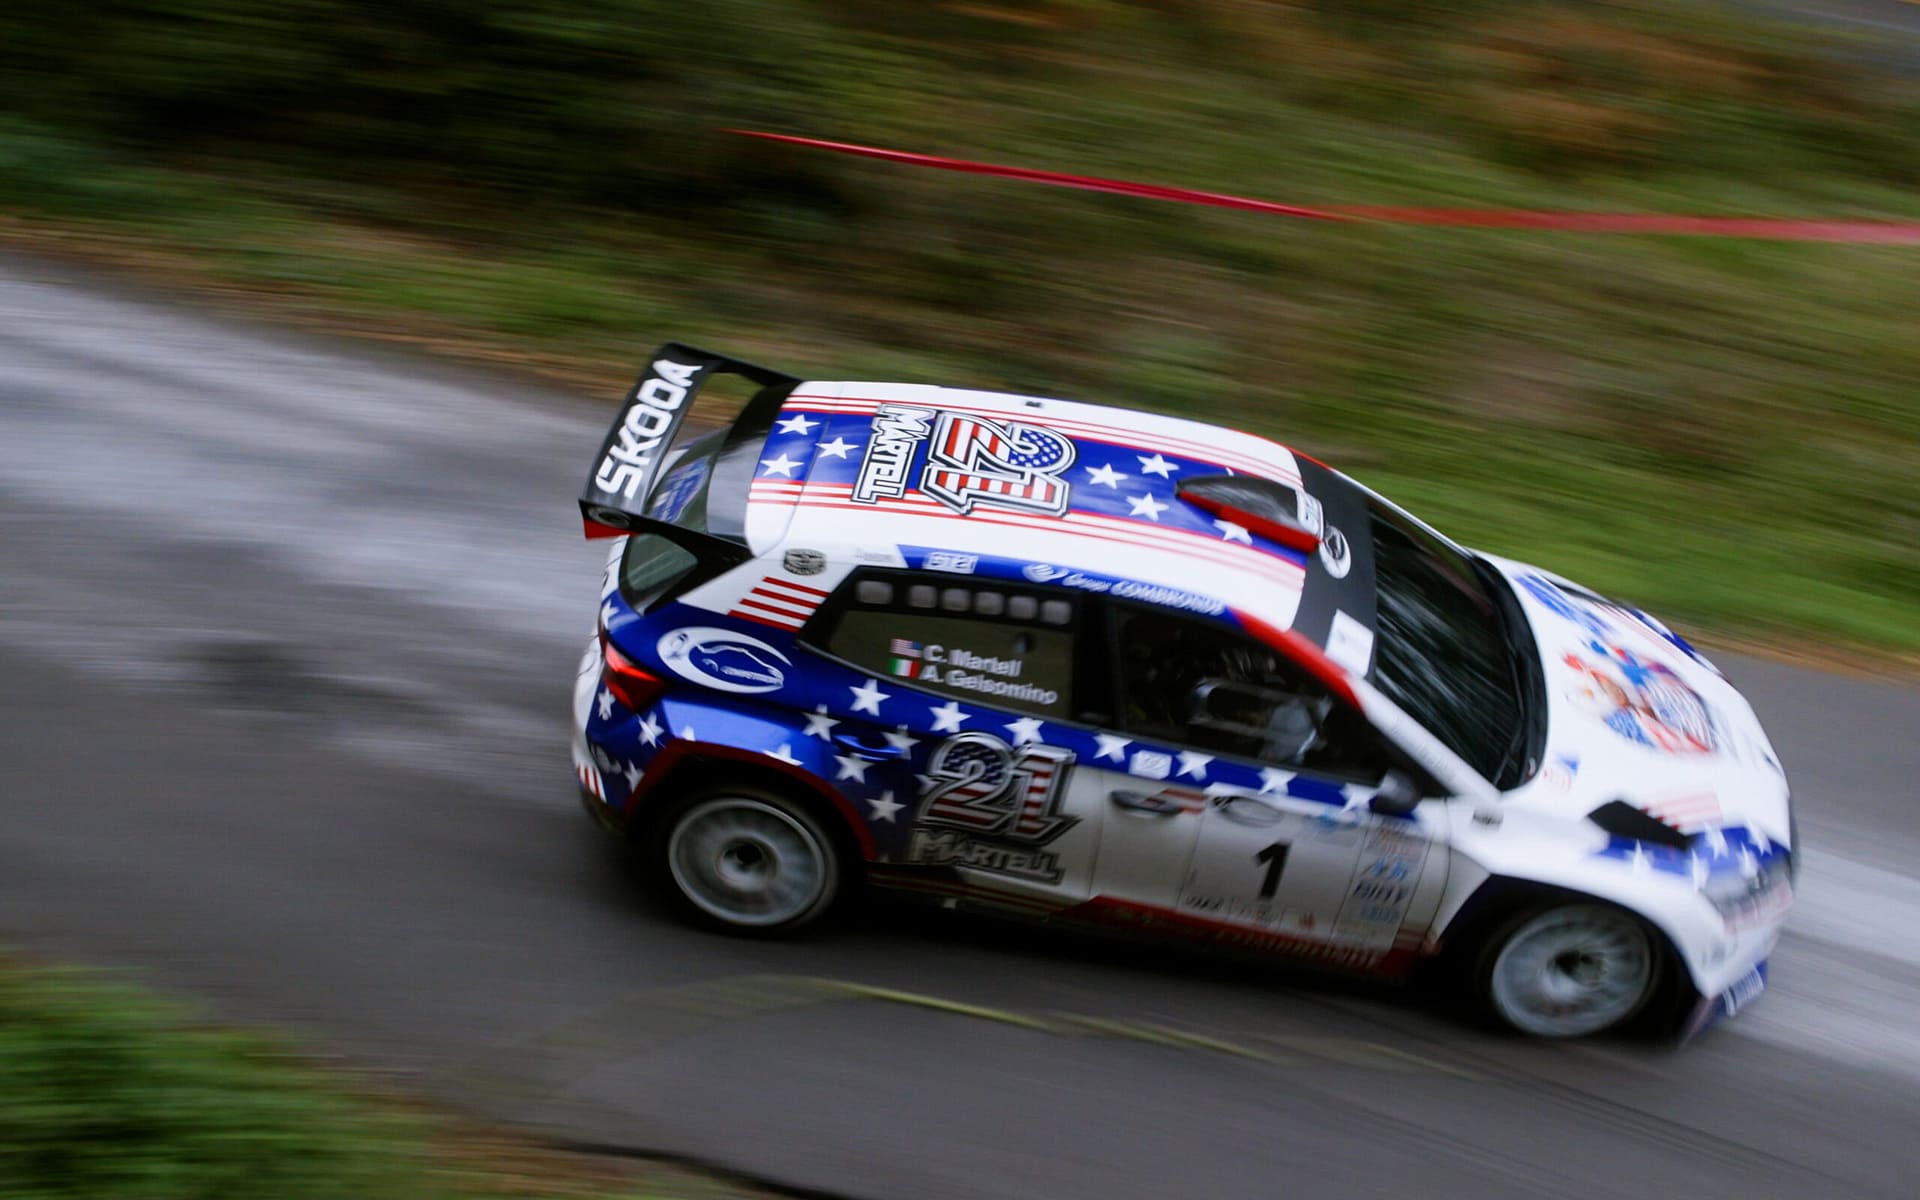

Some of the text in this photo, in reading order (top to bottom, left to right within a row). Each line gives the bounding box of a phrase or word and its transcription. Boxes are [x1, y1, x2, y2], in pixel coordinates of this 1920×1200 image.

[595, 359, 704, 500] SKODA
[851, 402, 937, 504] MARTELL
[919, 409, 1077, 517] 21
[918, 664, 944, 684] A.
[921, 643, 1022, 678] C. Martell
[918, 731, 1082, 847] 21
[908, 828, 1067, 887] MARTELL
[1255, 840, 1292, 900] 1
